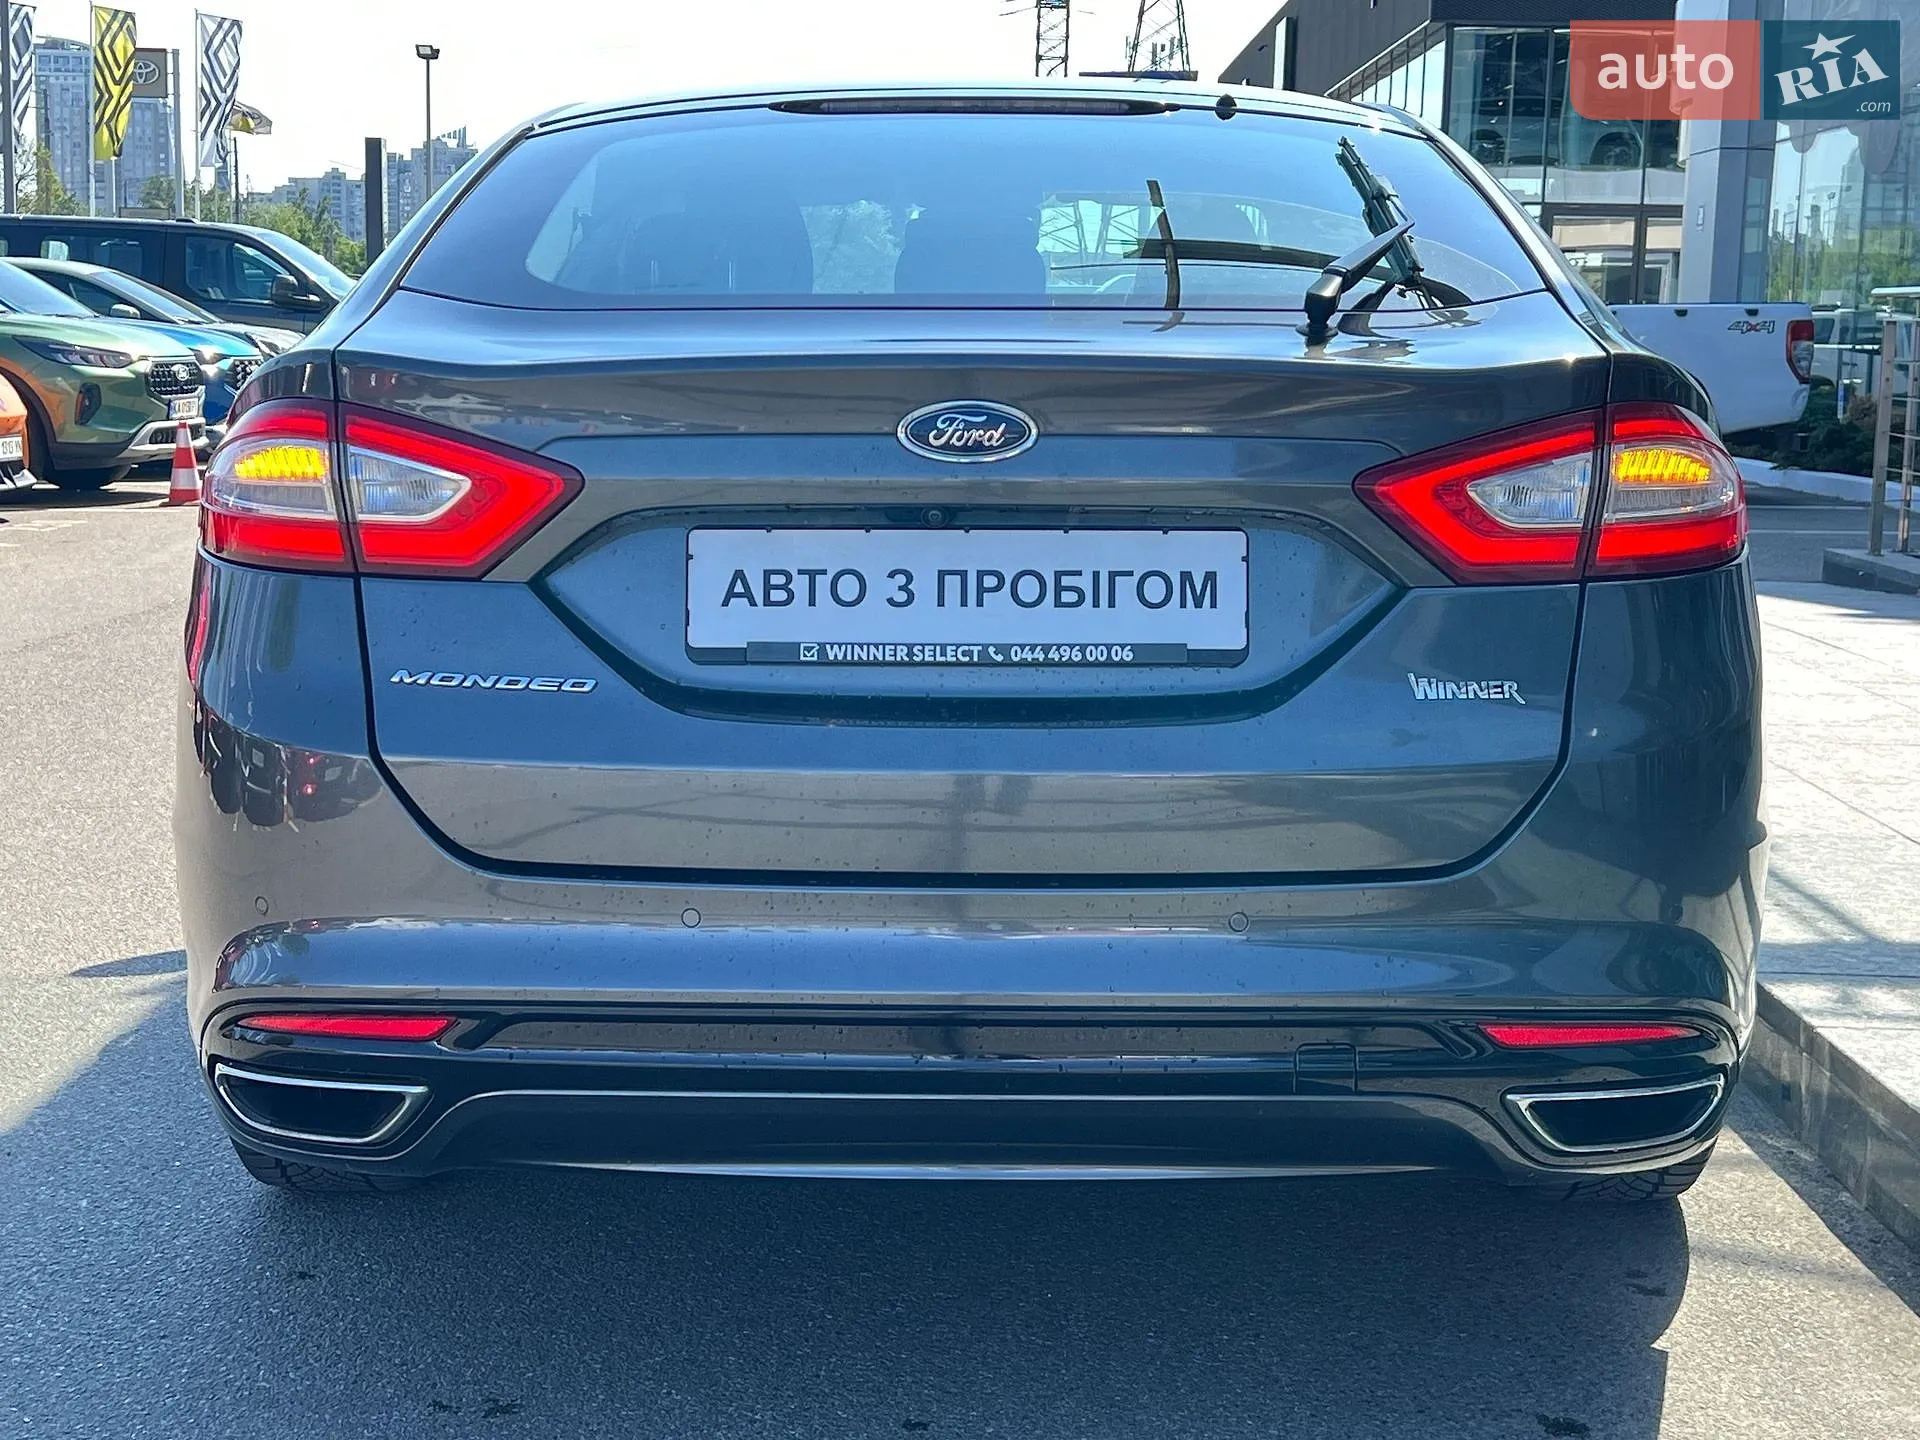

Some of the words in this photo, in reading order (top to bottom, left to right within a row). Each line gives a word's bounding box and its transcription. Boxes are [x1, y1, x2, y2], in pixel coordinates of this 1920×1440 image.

[928, 413, 1008, 447] Ford
[720, 568, 868, 608] АВТО
[936, 569, 1218, 609] ПРОБІГОМ
[825, 643, 909, 662] WINNER
[912, 644, 983, 663] SELECT
[1010, 645, 1045, 663] 044
[1048, 645, 1083, 663] 496
[1085, 645, 1108, 663] 00
[1111, 645, 1134, 663] 06
[390, 668, 599, 694] MONDEO
[1407, 672, 1526, 705] WINNER
